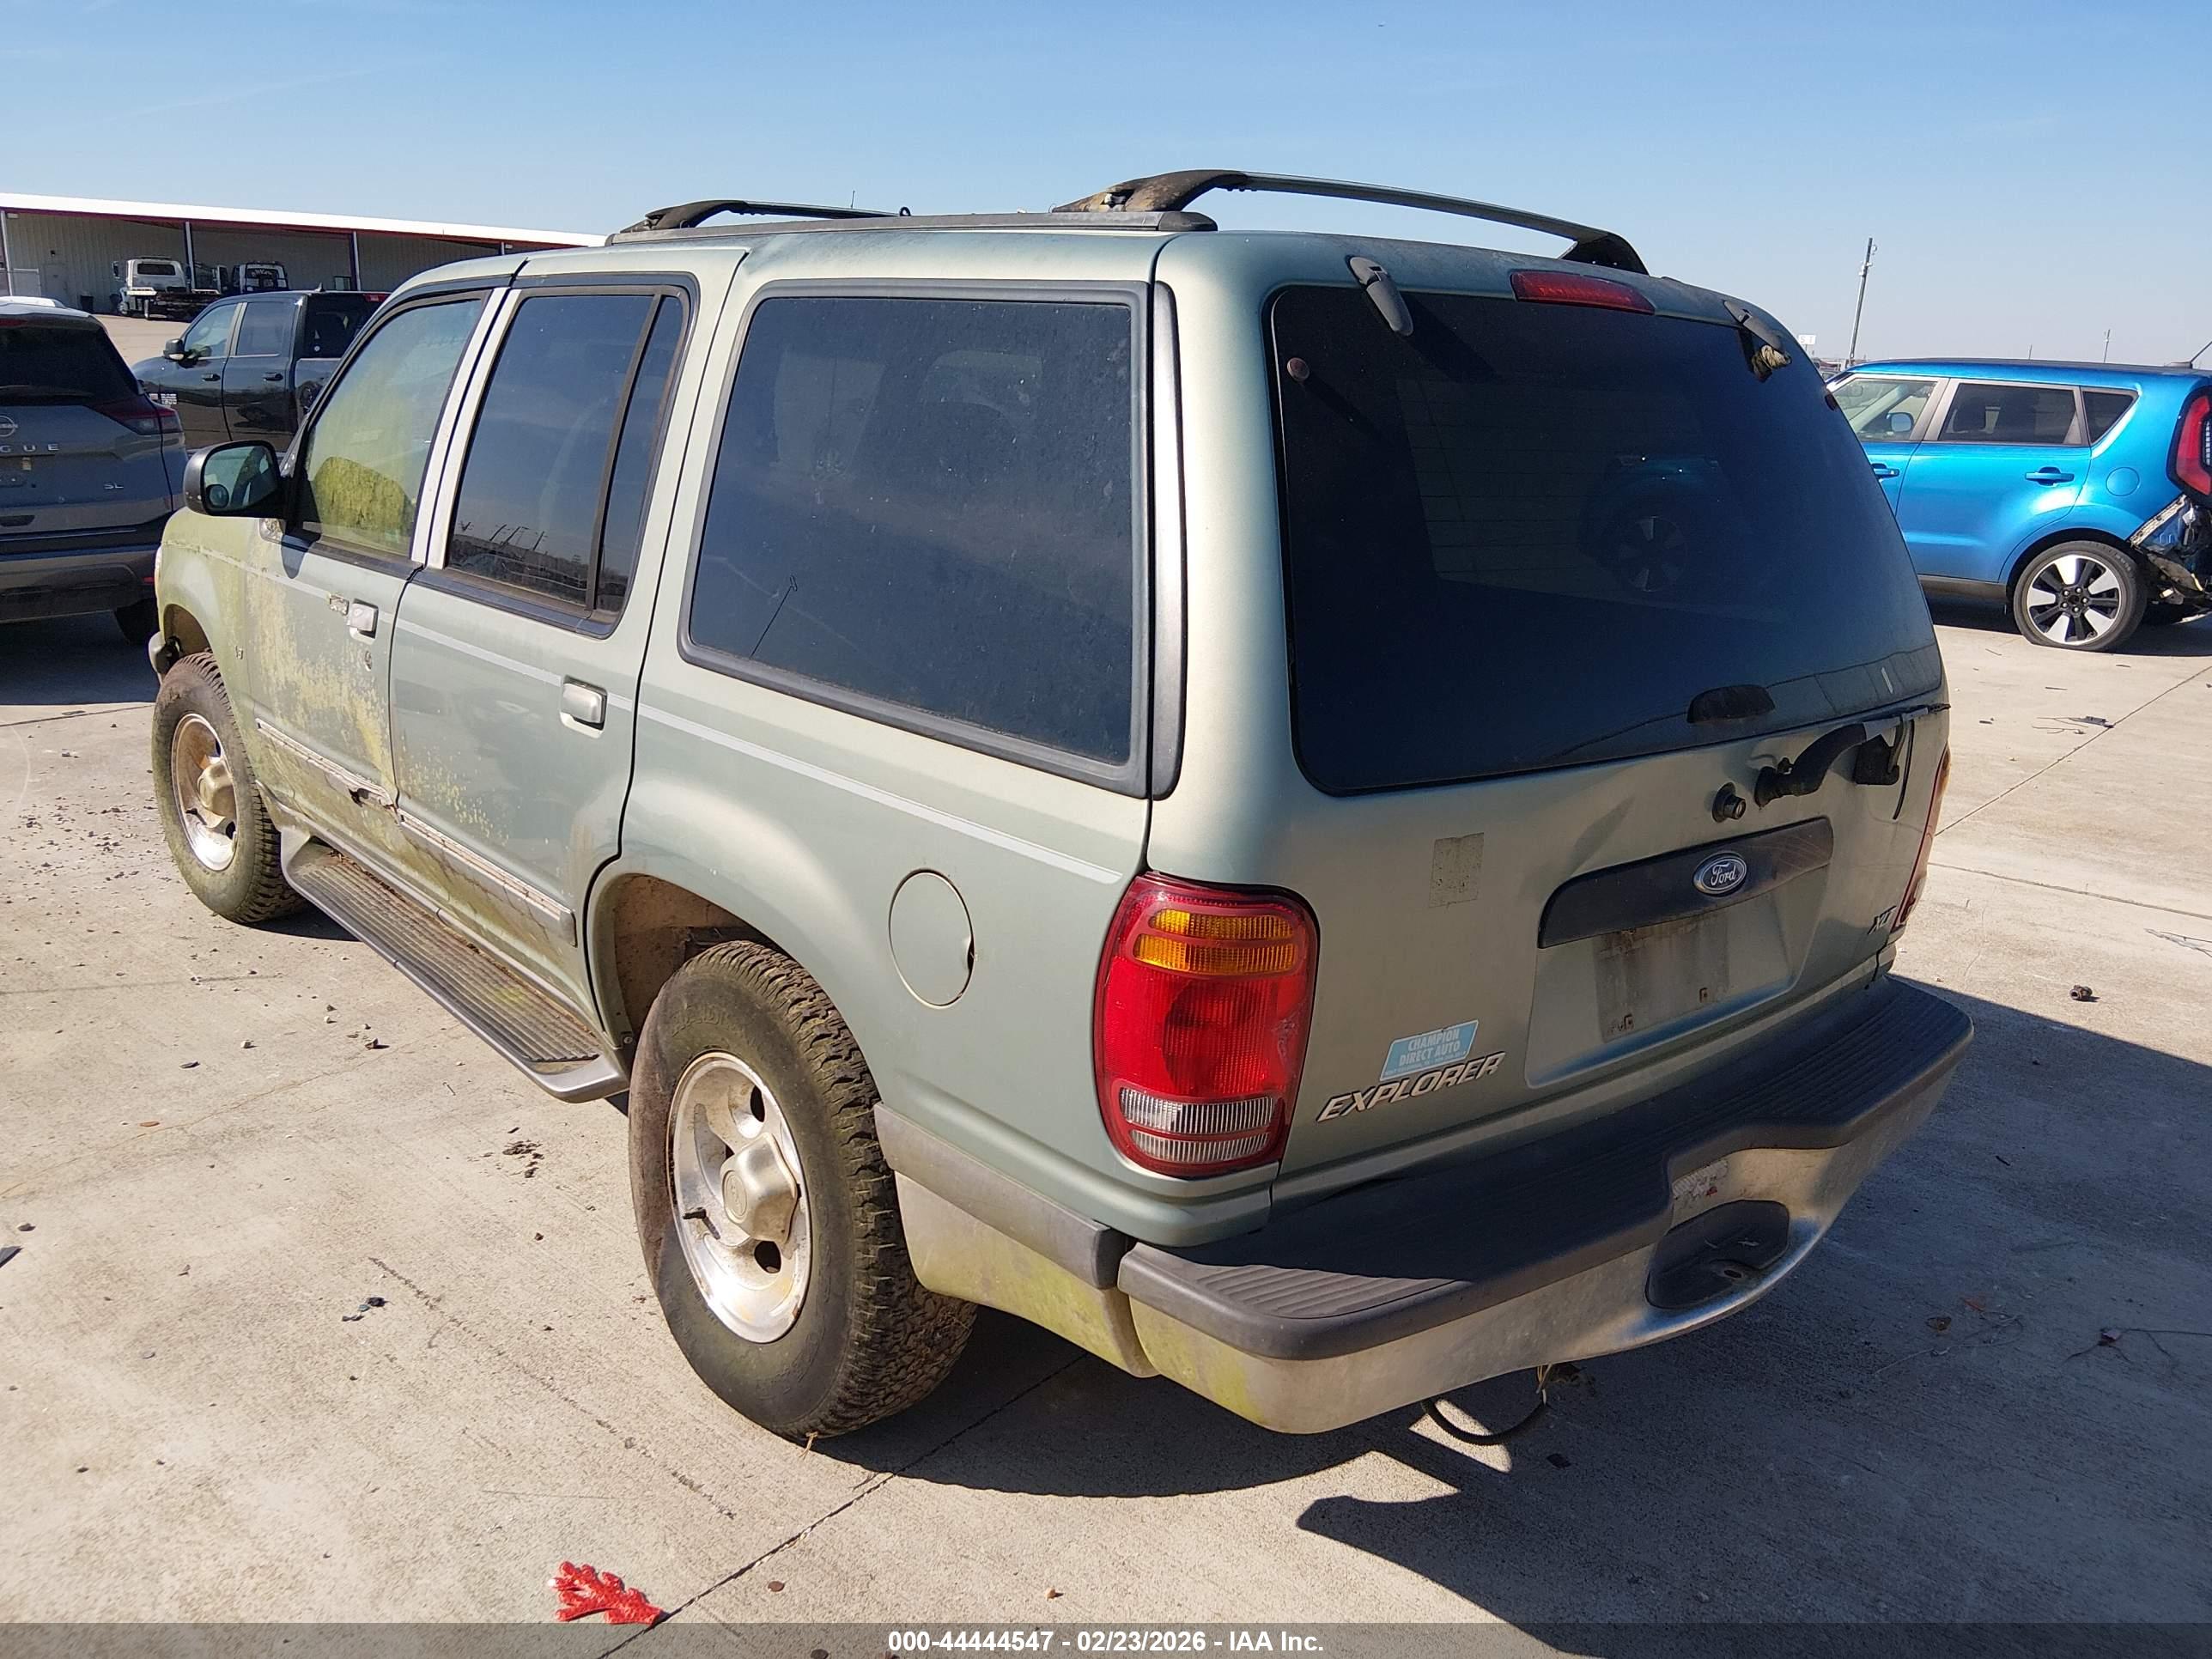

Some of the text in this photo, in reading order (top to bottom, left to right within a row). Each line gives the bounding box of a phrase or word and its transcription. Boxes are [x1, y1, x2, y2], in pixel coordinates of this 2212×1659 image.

[1711, 862, 1736, 886] Ford
[1867, 904, 1897, 935] XLT
[1399, 1047, 1435, 1066] DIRECT
[1435, 1040, 1460, 1059] AUTO
[1407, 1029, 1459, 1052] CHAMPION
[1316, 1051, 1506, 1123] EXPLORER
